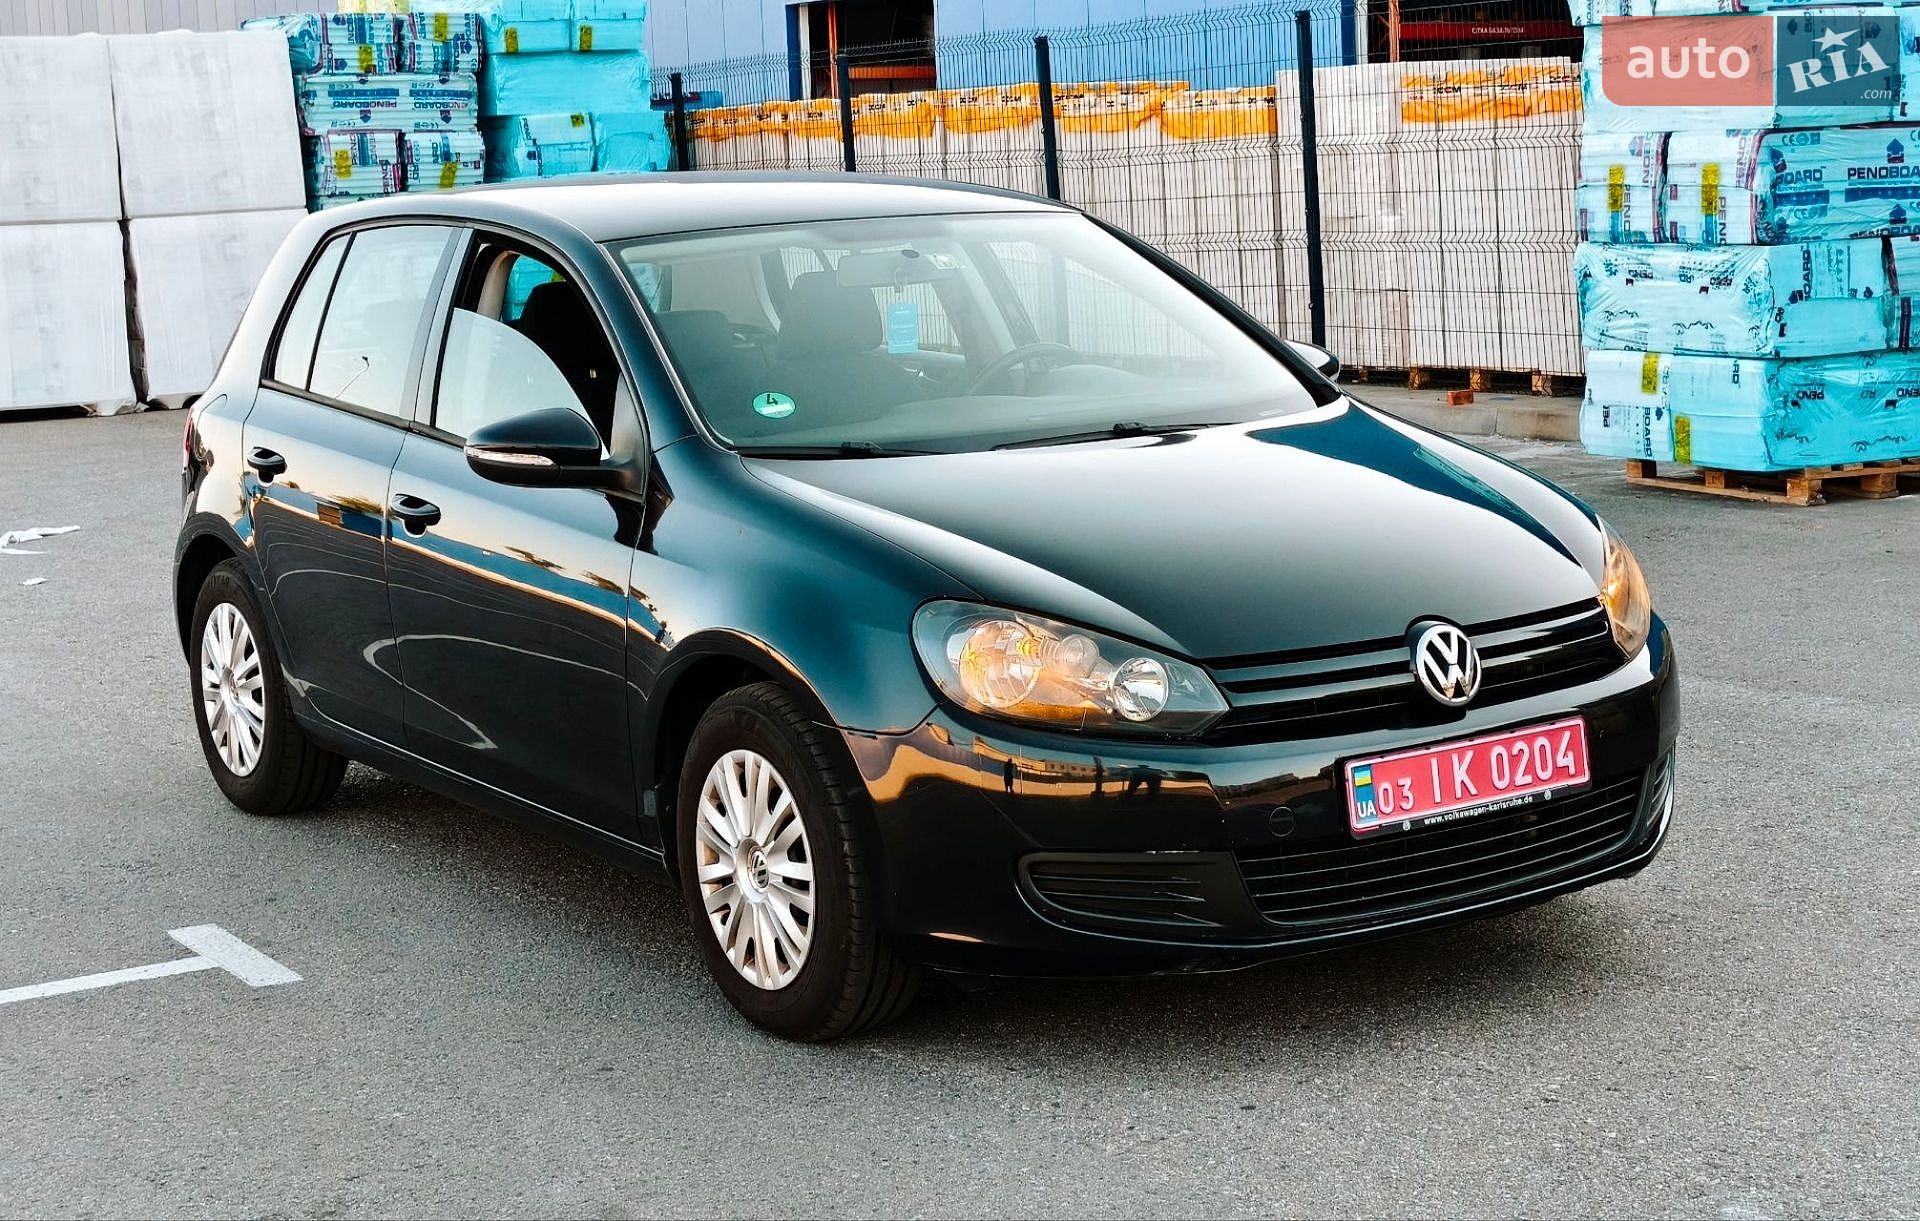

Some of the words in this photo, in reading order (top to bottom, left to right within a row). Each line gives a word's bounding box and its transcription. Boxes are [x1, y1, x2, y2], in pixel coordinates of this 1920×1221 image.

[766, 393, 778, 405] 4
[1377, 777, 1415, 814] 03
[1489, 730, 1577, 790] 0204
[1357, 801, 1377, 818] UA
[1423, 795, 1533, 825] www.volkswagen-karlsruhe.de
